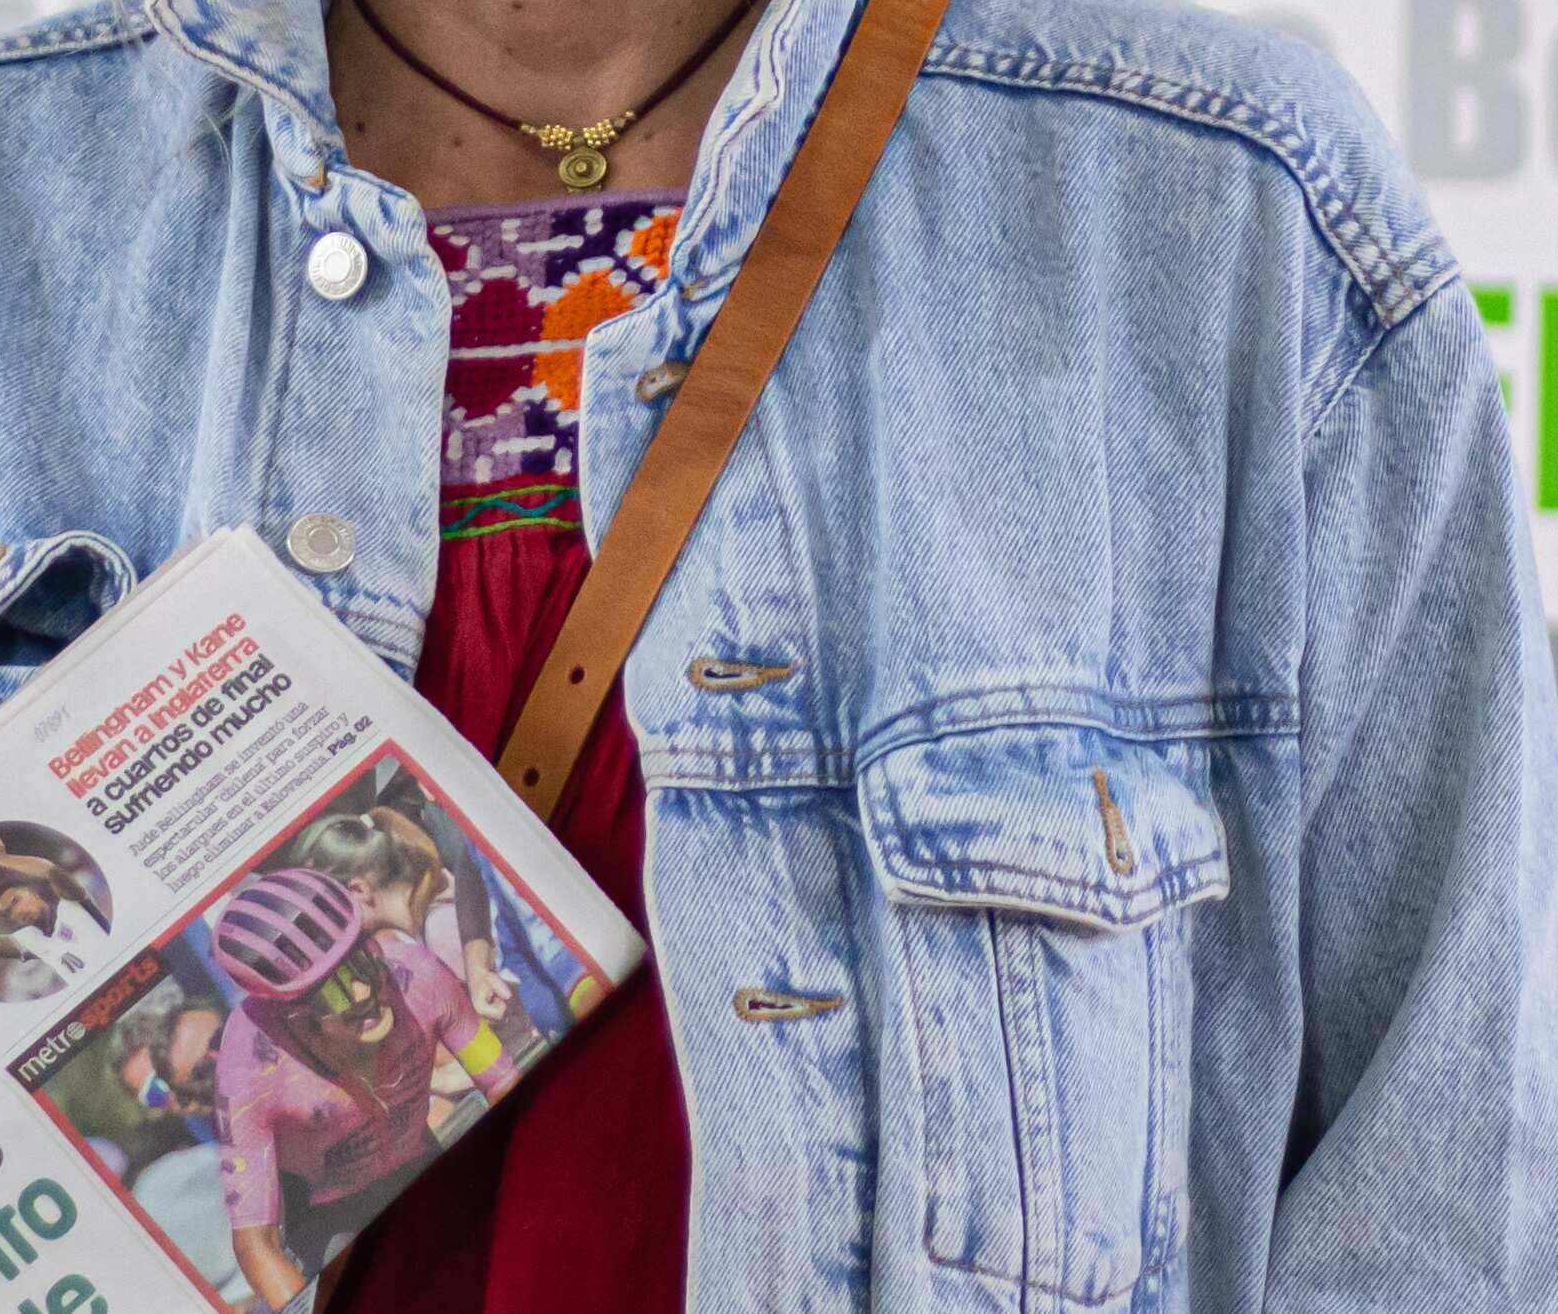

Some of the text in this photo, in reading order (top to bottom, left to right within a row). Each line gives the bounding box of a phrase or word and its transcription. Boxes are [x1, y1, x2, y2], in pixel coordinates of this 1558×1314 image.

[47, 613, 246, 780] Bellingham y Kane
[65, 636, 260, 800] llevan a Inglaterra
[86, 653, 275, 817] a cuartos de final
[103, 673, 292, 835] sufriendo mucho
[353, 715, 373, 733] 02
